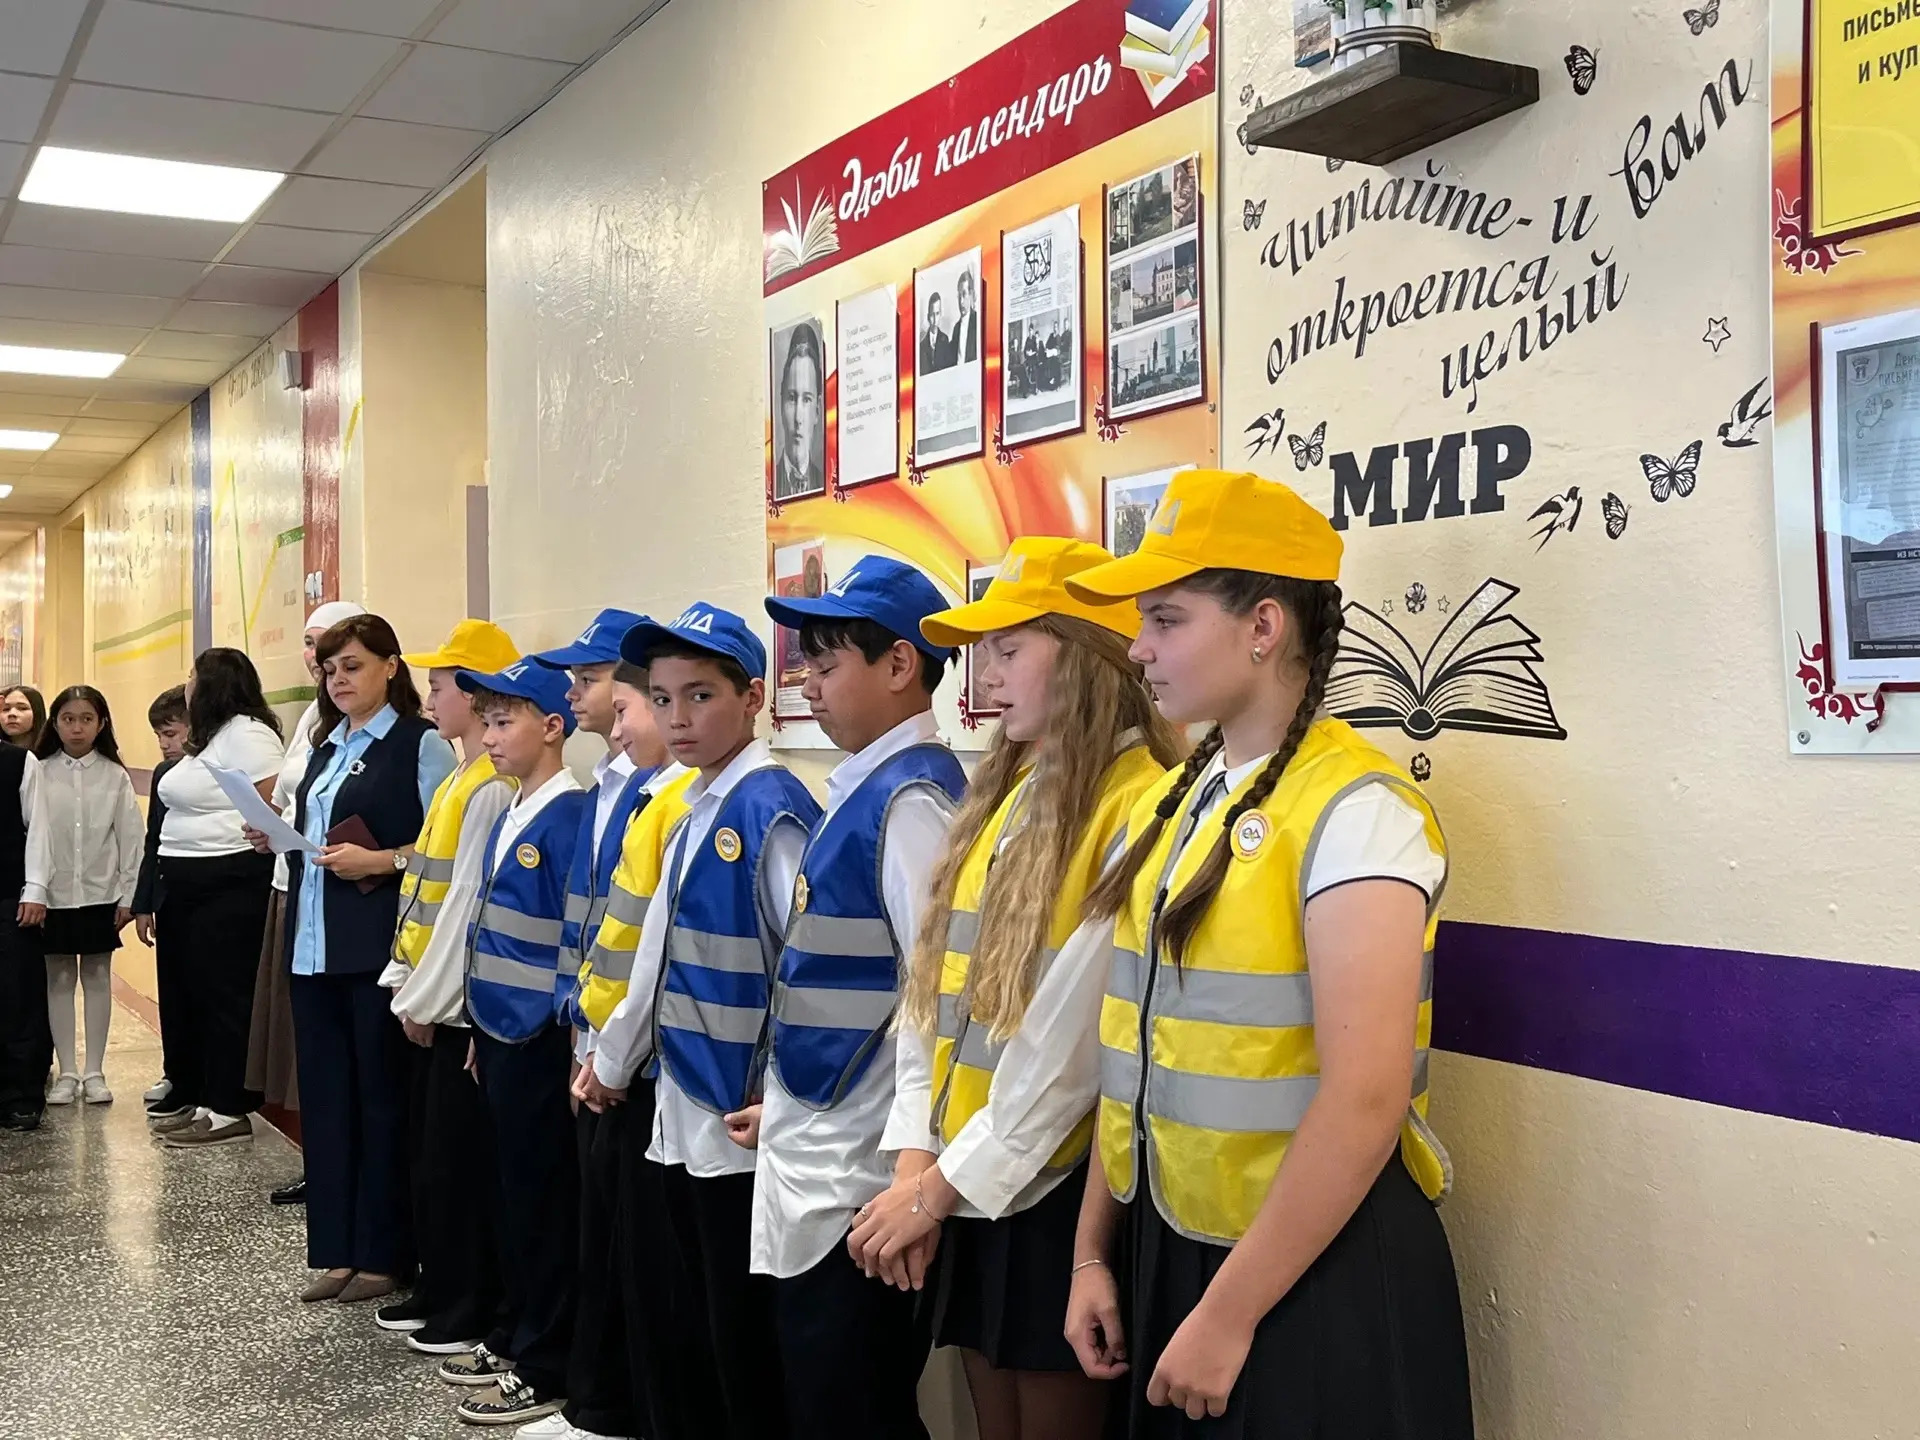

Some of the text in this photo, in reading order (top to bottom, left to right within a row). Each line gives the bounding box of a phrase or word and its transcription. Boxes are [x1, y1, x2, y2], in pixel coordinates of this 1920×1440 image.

[934, 55, 1113, 175] календарь
[1266, 254, 1559, 386] откроется
[1440, 246, 1630, 414] целый
[1329, 425, 1531, 531] МИР
[669, 610, 714, 635] ИД
